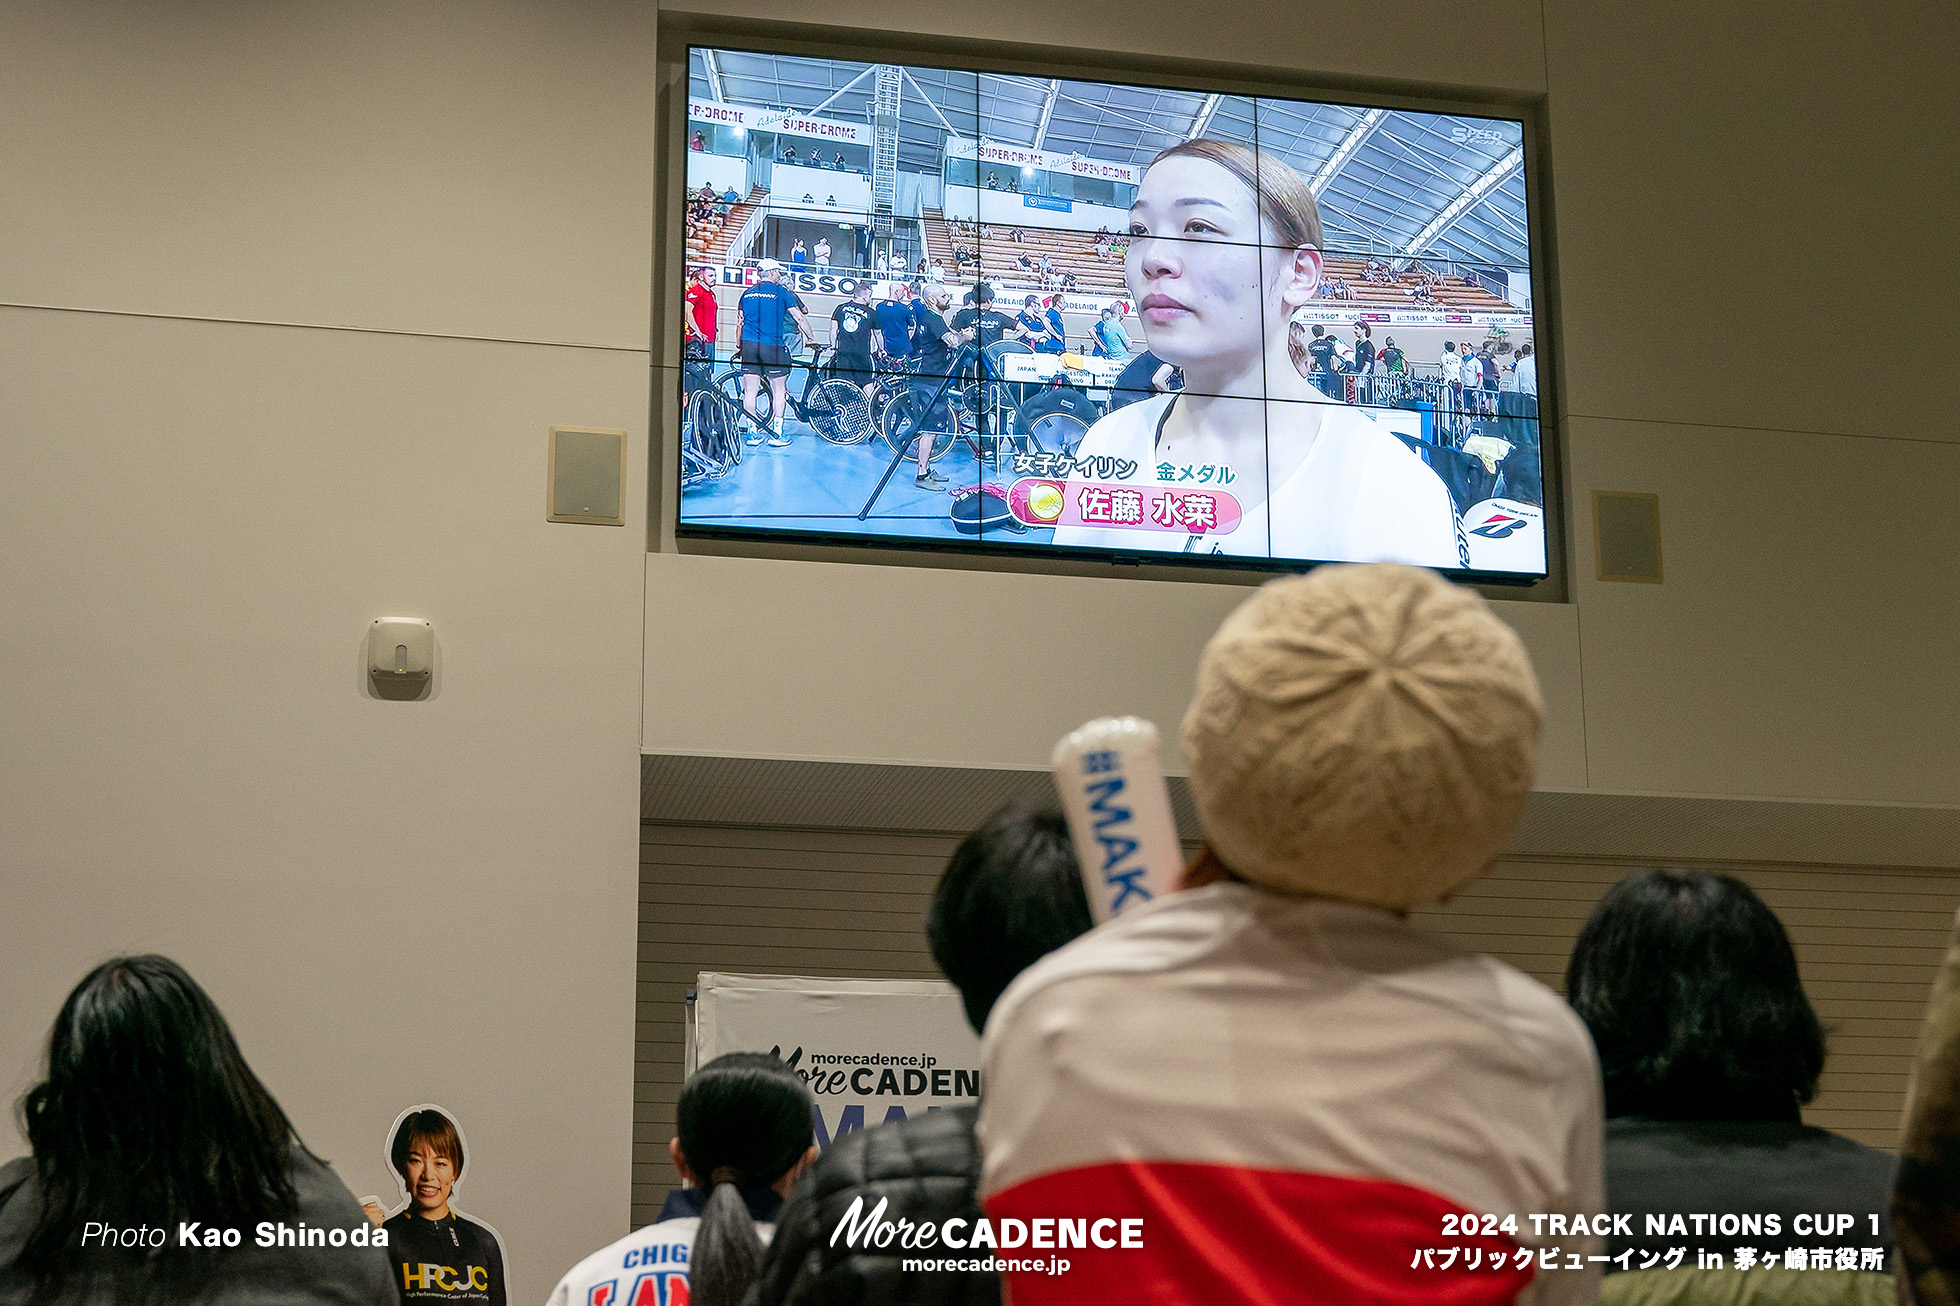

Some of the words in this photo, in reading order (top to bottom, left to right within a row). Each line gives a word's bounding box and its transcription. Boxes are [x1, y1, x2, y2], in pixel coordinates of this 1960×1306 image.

[783, 118, 857, 139] SUPER-DROME
[1014, 452, 1138, 480] 女子ケイリン
[1156, 461, 1236, 485] 金メダル
[1079, 488, 1142, 523] 佐藤
[1151, 493, 1217, 529] 水菜
[810, 1052, 937, 1069] morecadence.jp
[402, 1262, 489, 1292] HPCJC
